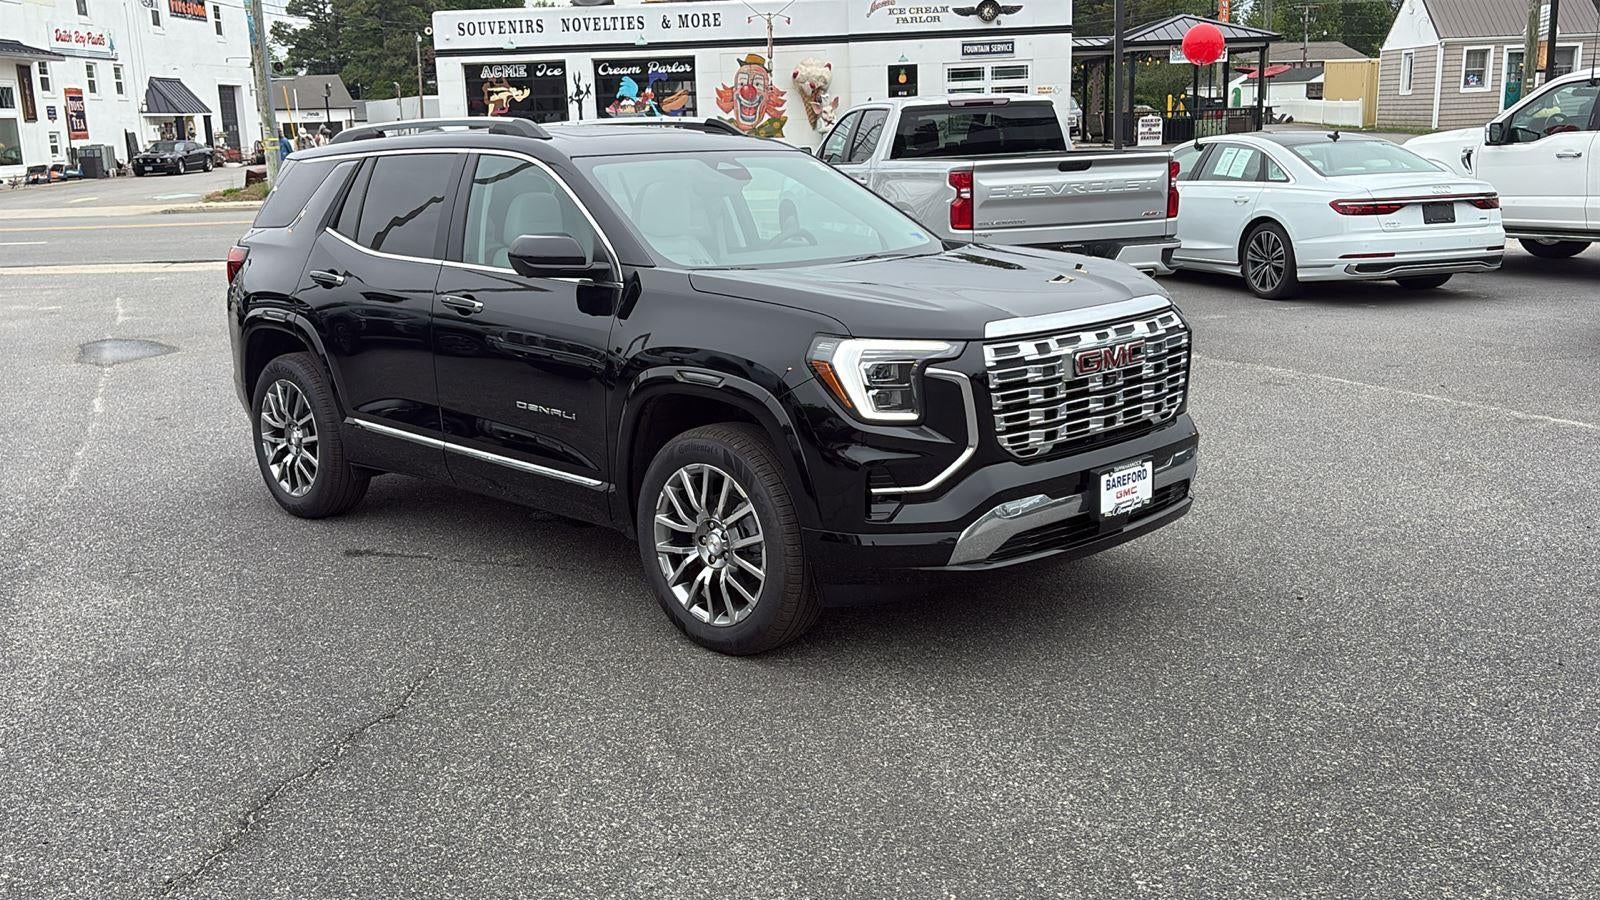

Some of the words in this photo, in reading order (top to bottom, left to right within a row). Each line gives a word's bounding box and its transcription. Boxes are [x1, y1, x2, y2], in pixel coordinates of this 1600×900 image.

[888, 7, 906, 16] ICE
[908, 5, 950, 15] CREAM
[457, 18, 544, 37] SOUVENIRS
[561, 15, 645, 33] NOVELTIES
[661, 14, 672, 30] &
[678, 12, 722, 28] MORE
[896, 15, 942, 25] PARLOR
[55, 28, 72, 43] Dutch
[74, 30, 86, 47] Boy
[87, 32, 106, 46] Paints
[963, 45, 990, 54] FOUNTAIN
[991, 43, 1013, 53] SERVICE
[480, 64, 528, 79] ACME
[535, 63, 564, 77] Ice
[598, 62, 642, 76] Cream
[647, 60, 692, 75] Parlor
[72, 117, 86, 130] TEA
[988, 178, 1158, 198] CHEVROLET
[1075, 340, 1146, 375] GMC
[515, 400, 576, 420] DENALI
[1106, 468, 1148, 491] BAREFORD
[1115, 486, 1138, 499] GMC
